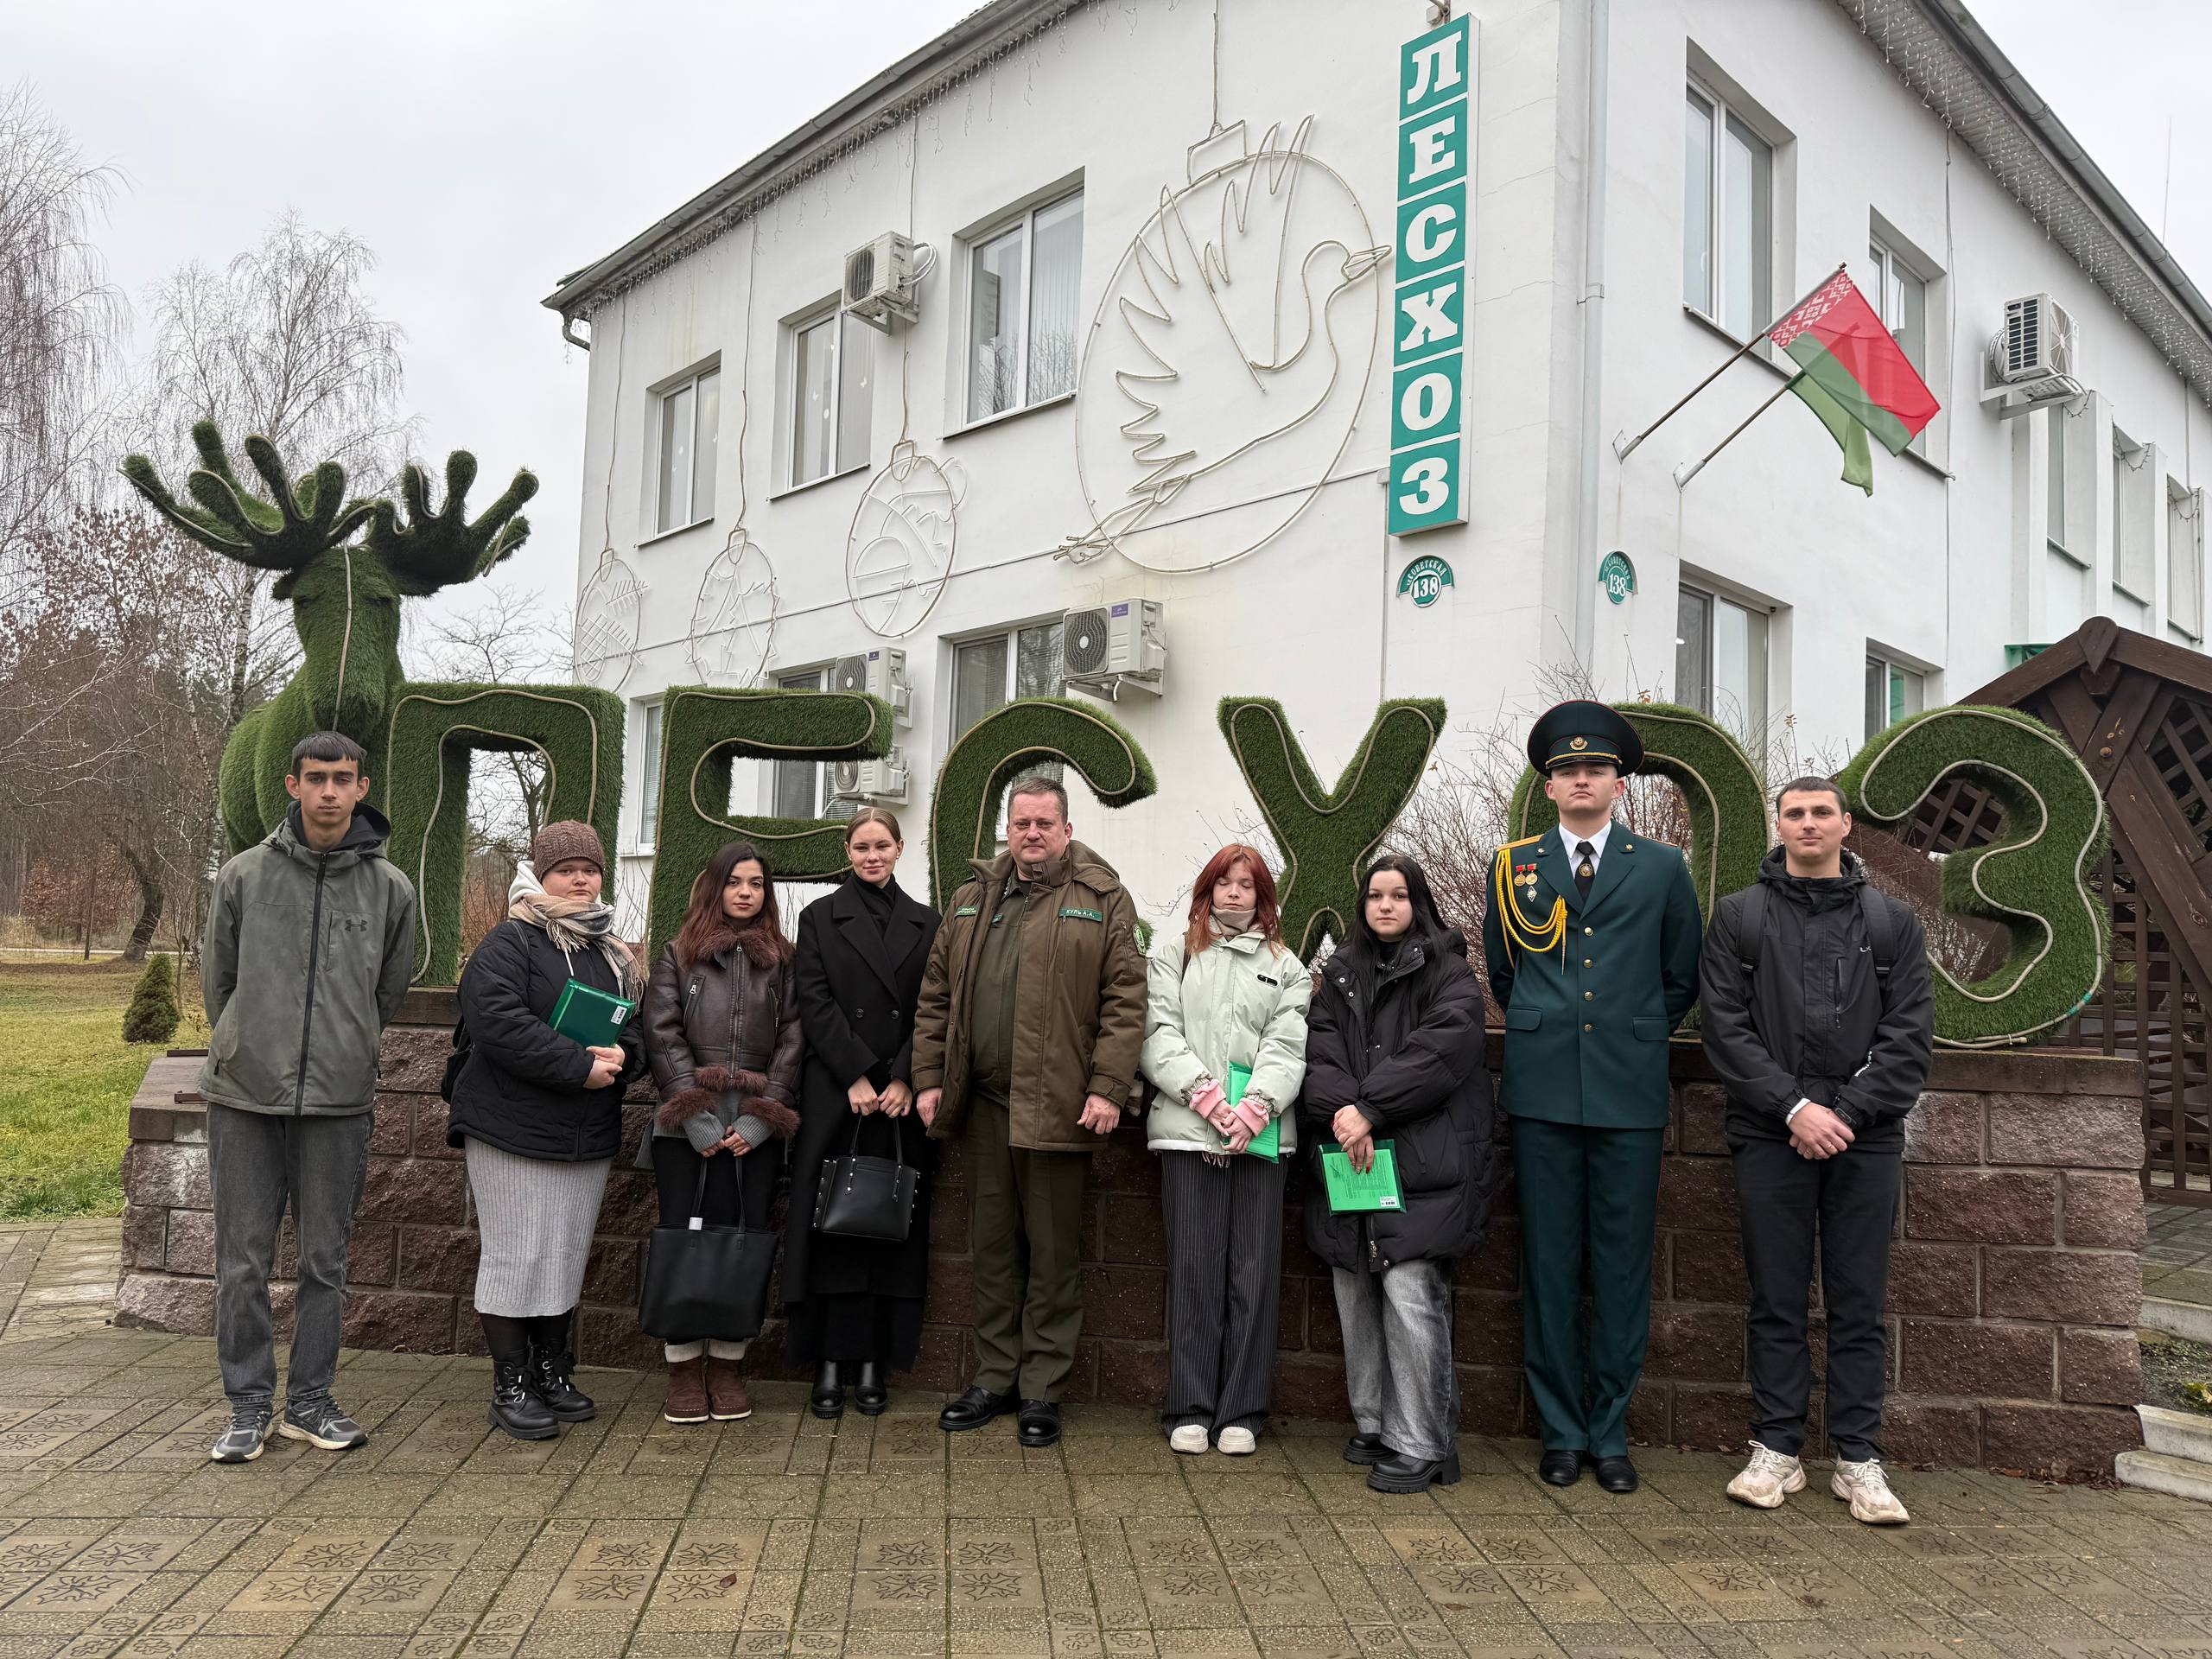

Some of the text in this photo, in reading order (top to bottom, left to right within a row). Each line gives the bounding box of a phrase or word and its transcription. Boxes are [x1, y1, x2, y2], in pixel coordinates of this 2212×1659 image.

[1400, 30, 1462, 515] ЛЕСХОЗ
[1408, 559, 1447, 580] СОВЕТСКАЯ
[1413, 576, 1440, 599] 138
[1609, 573, 1626, 597] 138
